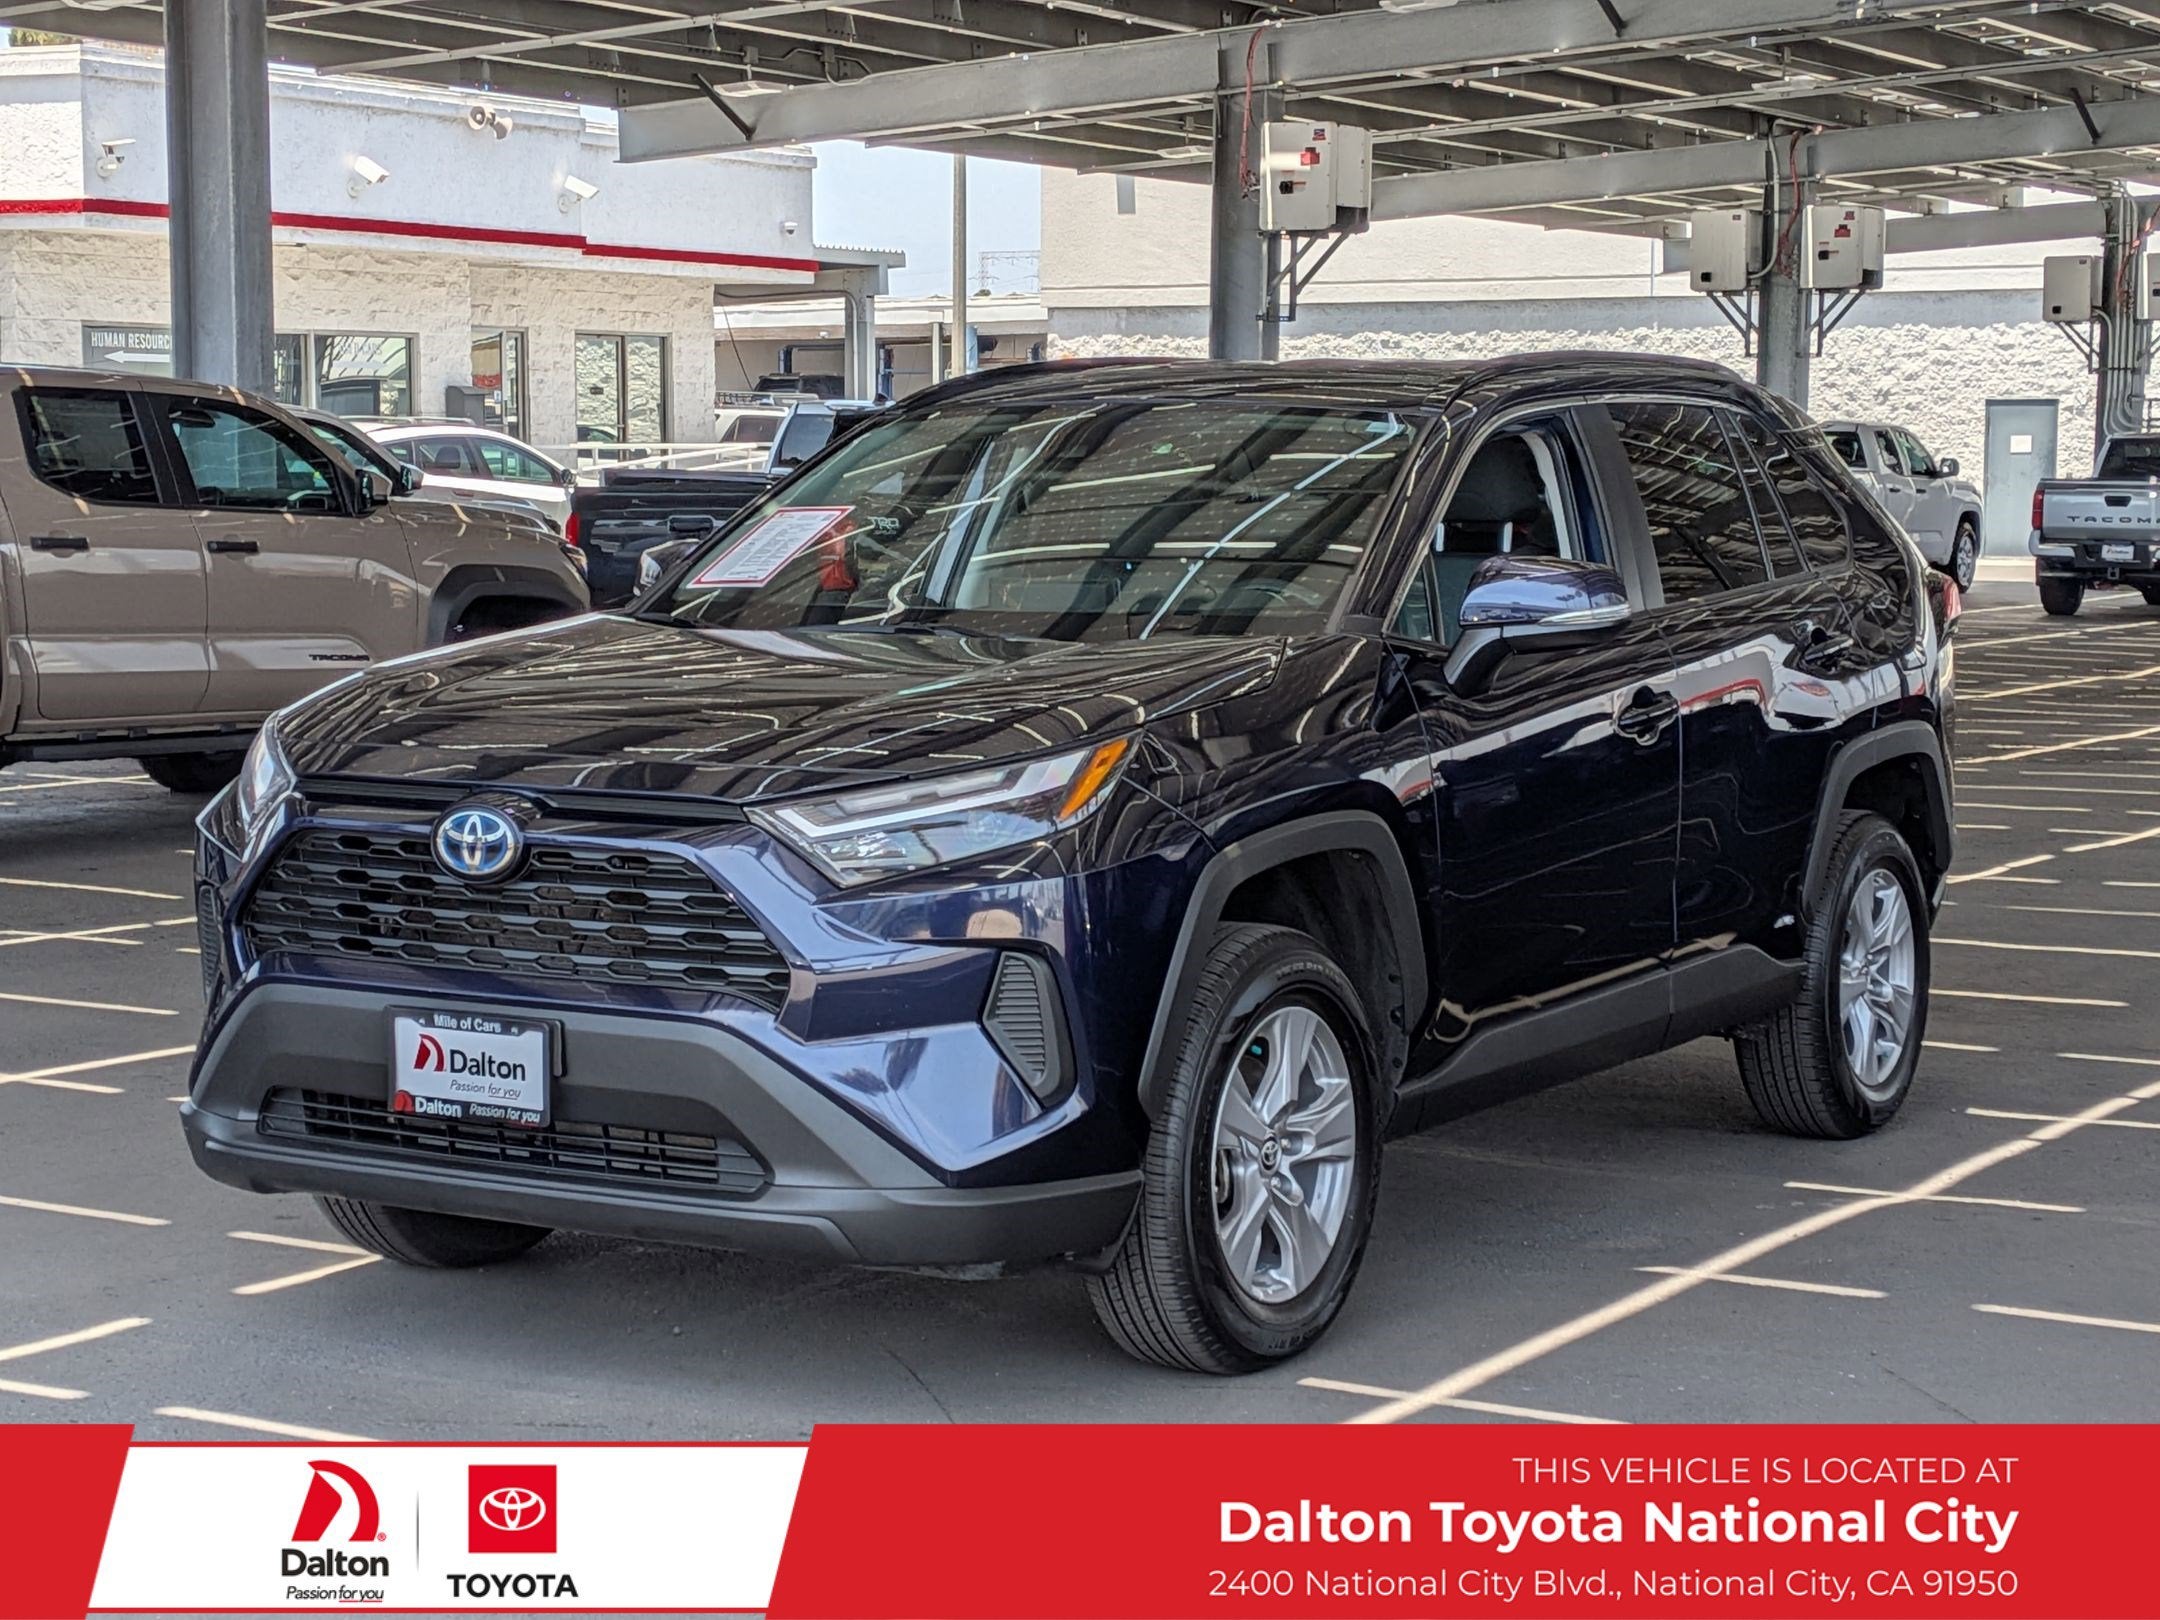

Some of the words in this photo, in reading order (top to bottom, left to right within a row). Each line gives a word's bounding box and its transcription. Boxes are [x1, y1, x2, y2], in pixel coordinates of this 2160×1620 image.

[91, 331, 126, 348] HUMAN
[128, 333, 173, 350] RESOURC
[308, 654, 370, 662] TACOMA
[433, 1013, 458, 1029] Mile
[459, 1016, 472, 1030] of
[473, 1017, 502, 1033] Cars
[449, 1049, 526, 1081] Dalton
[449, 1079, 486, 1094] Passion
[487, 1083, 502, 1096] for
[503, 1088, 522, 1099] you
[414, 1097, 462, 1118] Dalton
[469, 1103, 505, 1119] Passion
[505, 1107, 521, 1121] for
[520, 1110, 541, 1124] you
